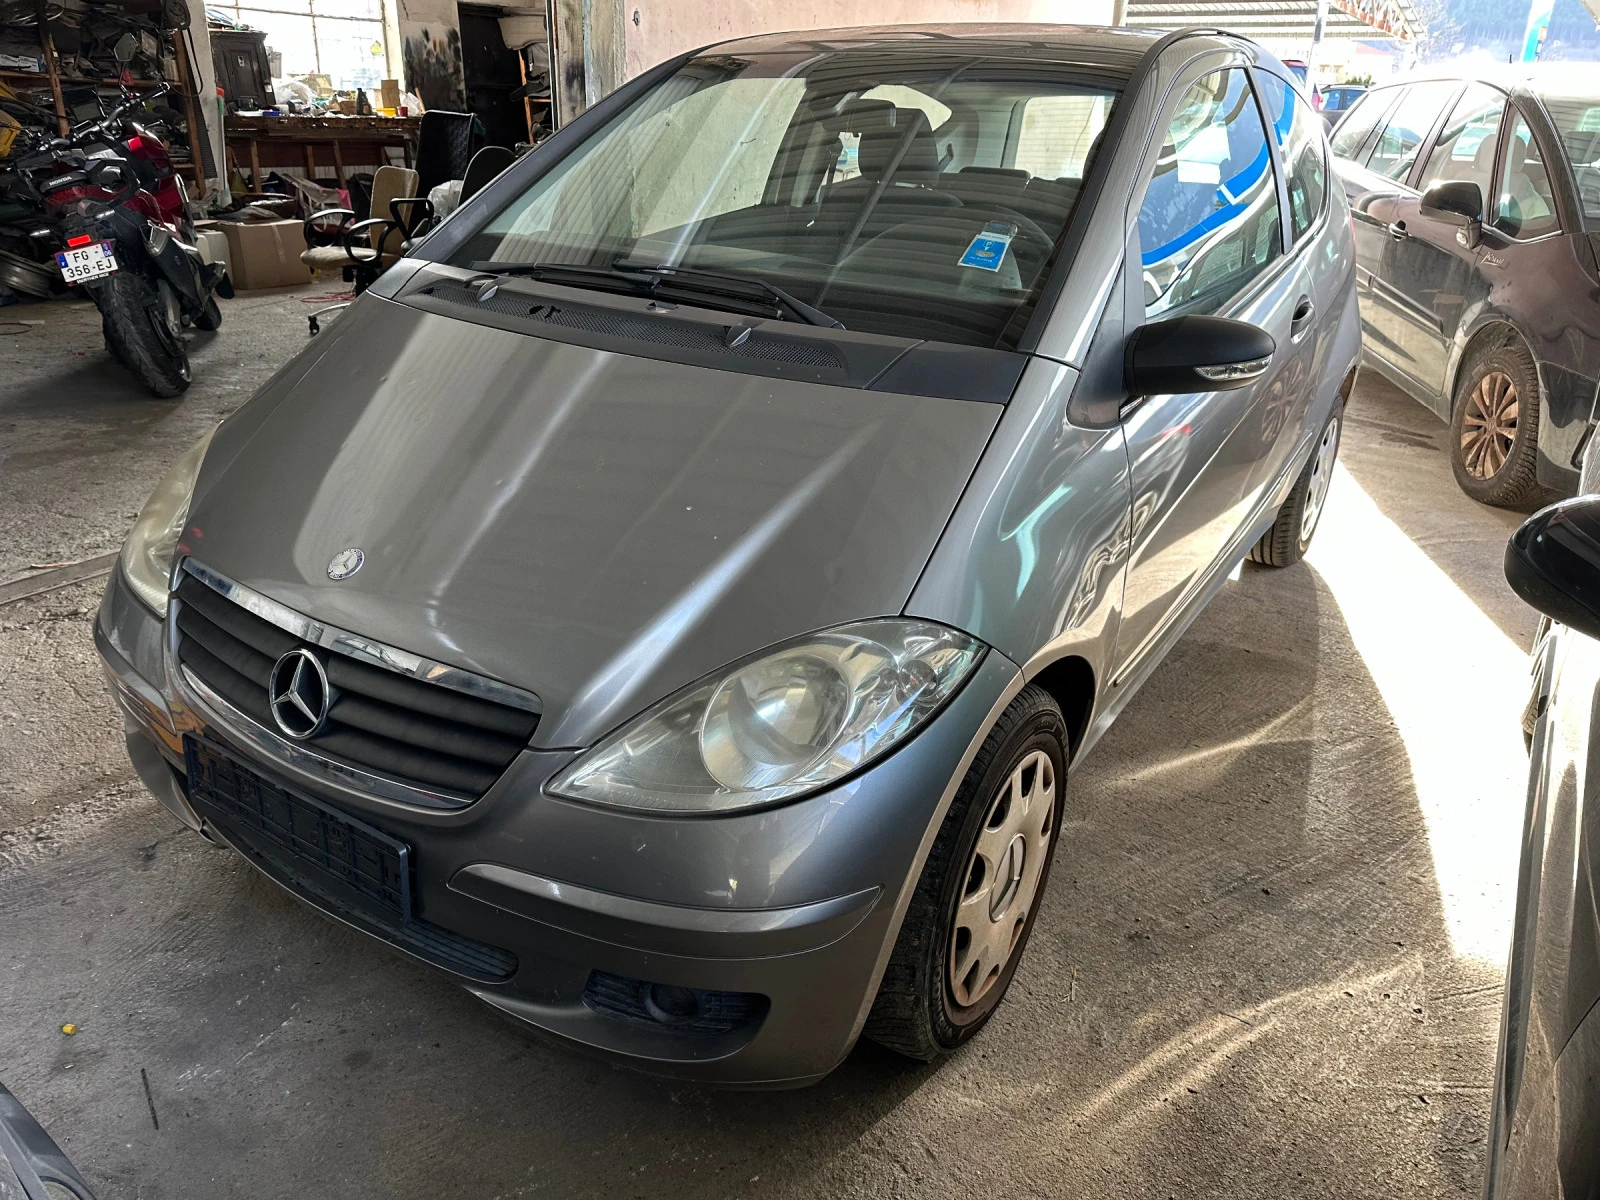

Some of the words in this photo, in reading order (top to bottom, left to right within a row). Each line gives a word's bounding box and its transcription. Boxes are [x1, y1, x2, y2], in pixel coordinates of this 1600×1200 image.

[49, 176, 72, 186] HONDA
[73, 250, 89, 263] FG
[66, 258, 112, 278] 356-EJ
